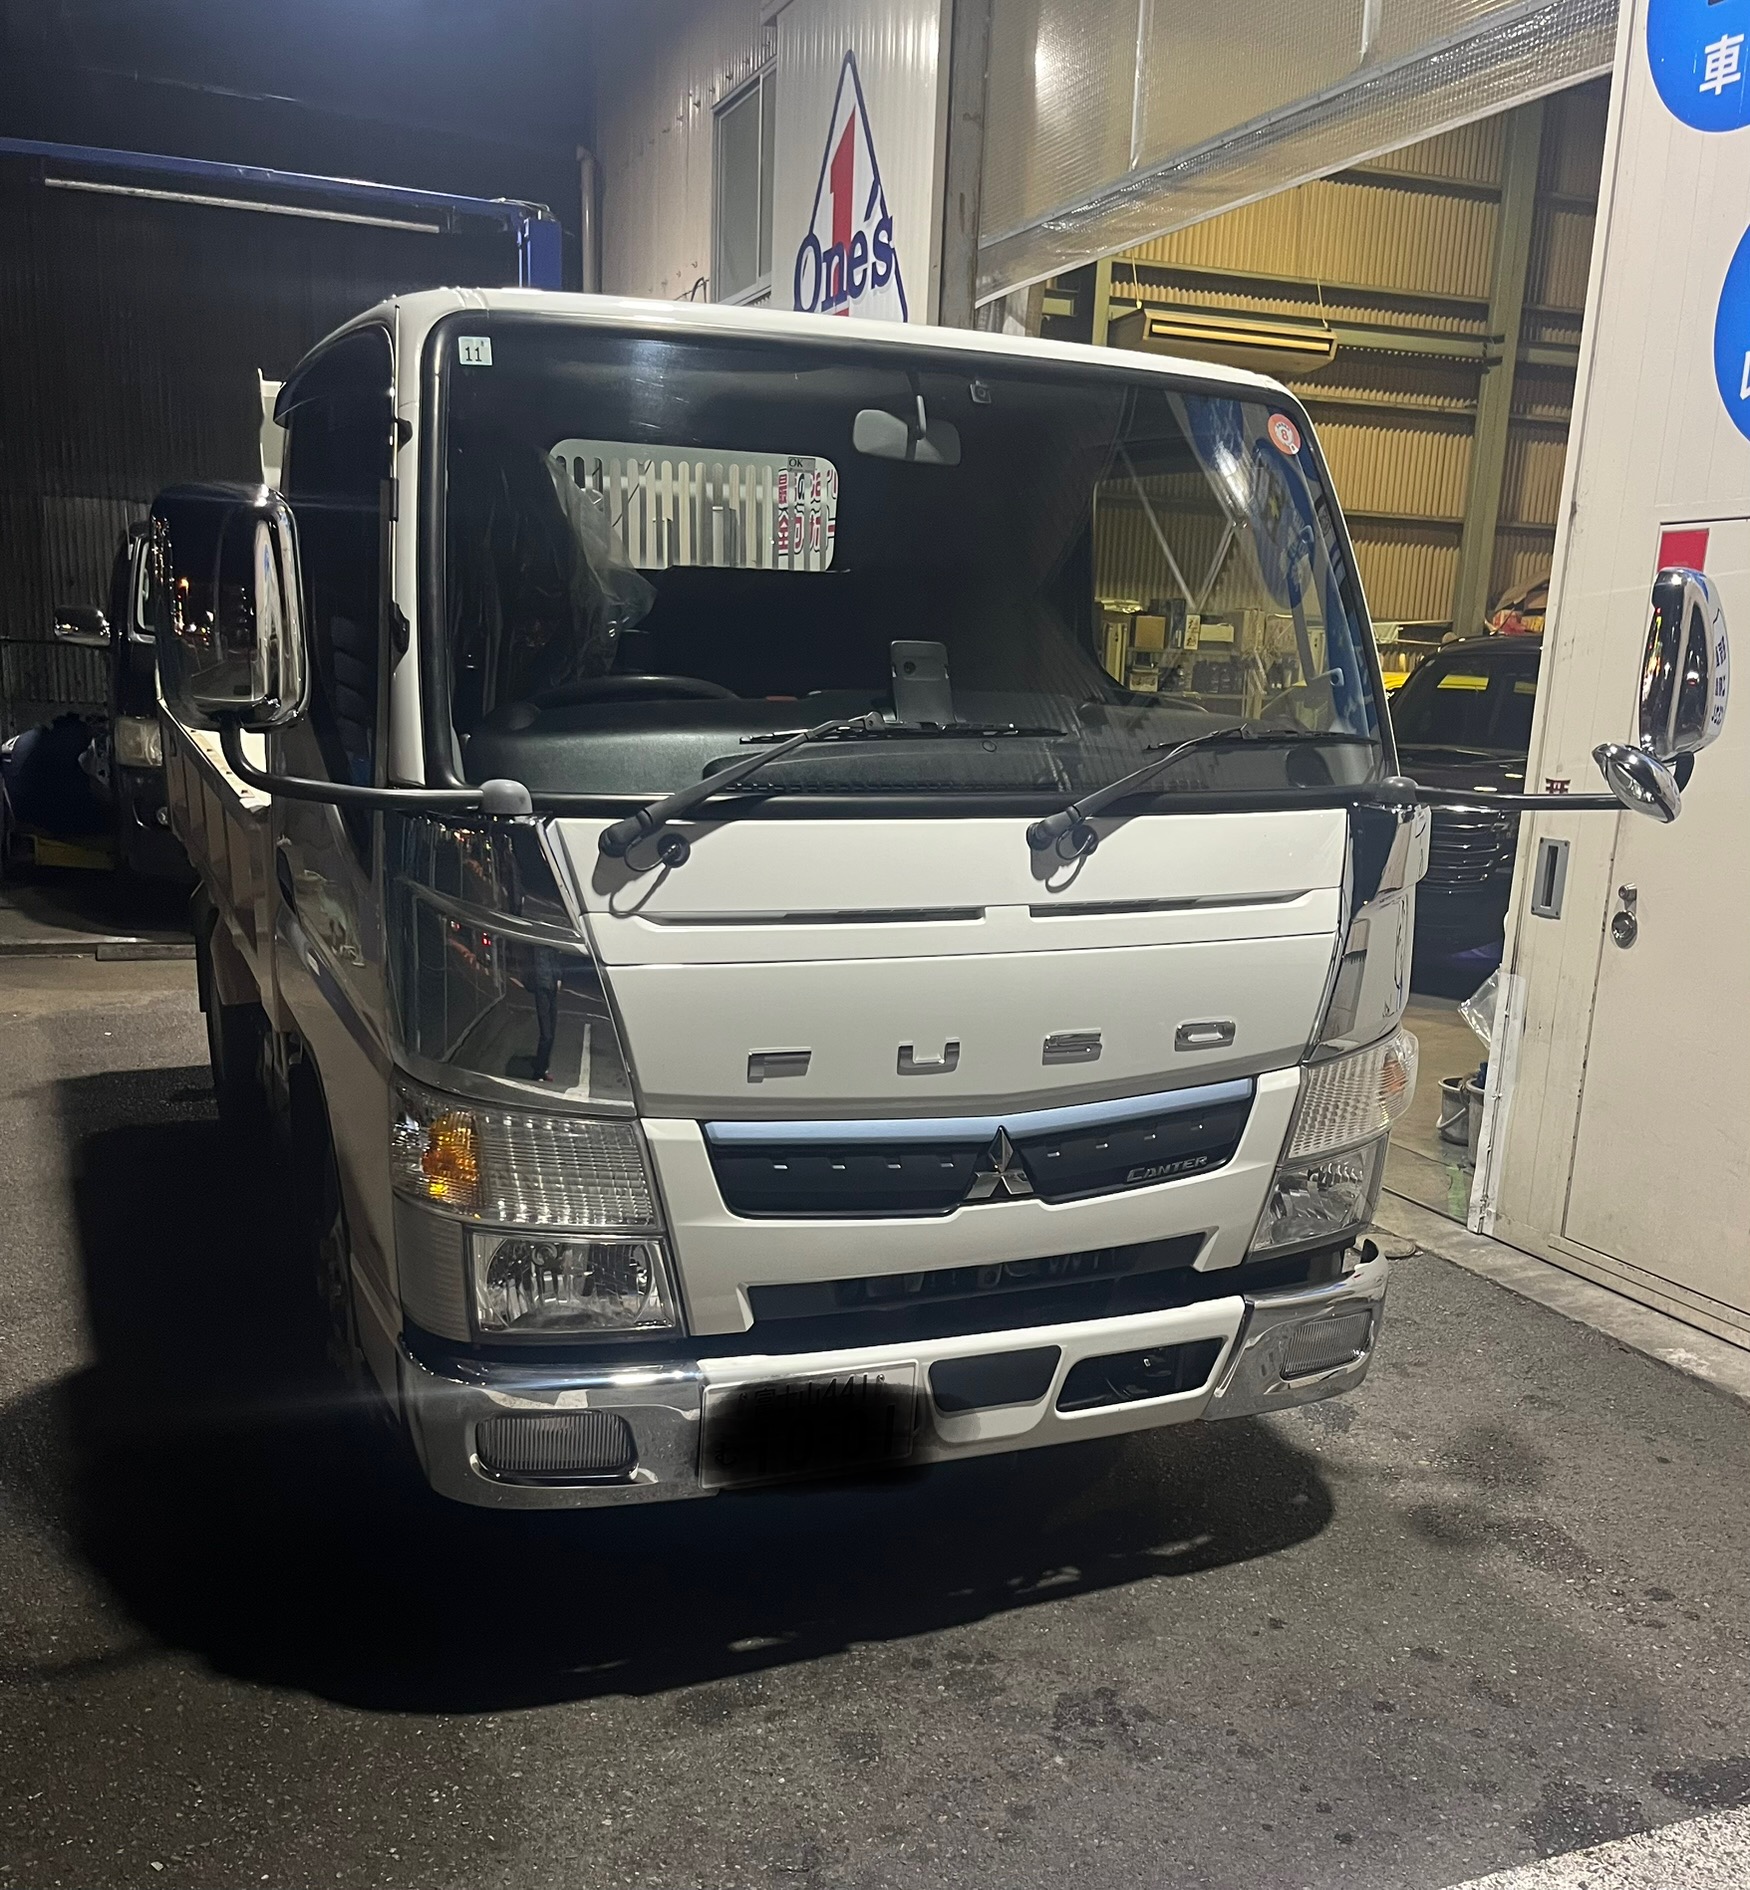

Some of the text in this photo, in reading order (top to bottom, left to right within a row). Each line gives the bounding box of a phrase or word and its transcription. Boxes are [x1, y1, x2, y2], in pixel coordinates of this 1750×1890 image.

[1699, 33, 1745, 96] 車
[465, 346, 482, 362] 11
[789, 458, 803, 467] OK
[746, 1019, 1237, 1083] FUSO
[1126, 1155, 1208, 1183] CANTER
